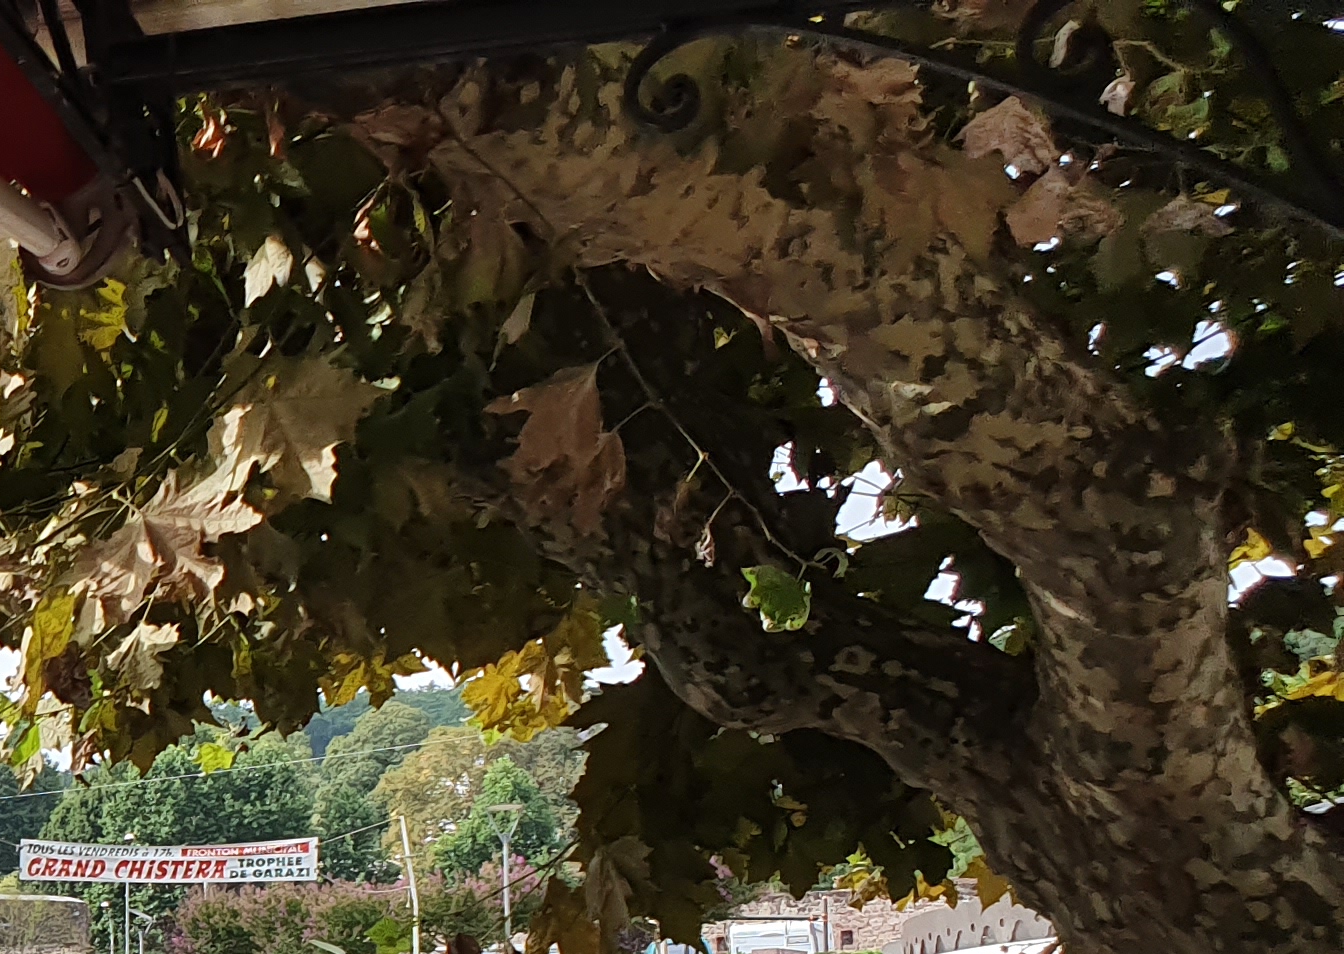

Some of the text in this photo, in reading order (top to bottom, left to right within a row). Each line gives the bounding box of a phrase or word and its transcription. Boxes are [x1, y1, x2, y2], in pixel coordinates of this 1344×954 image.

[27, 843, 55, 855] TOUS
[57, 846, 75, 856] LES
[78, 846, 139, 857] VENDREDIS
[186, 848, 240, 857] FRONTON
[27, 857, 107, 878] GRAND
[237, 856, 303, 868] TROPHEE
[229, 867, 310, 879] DE GARAZI
